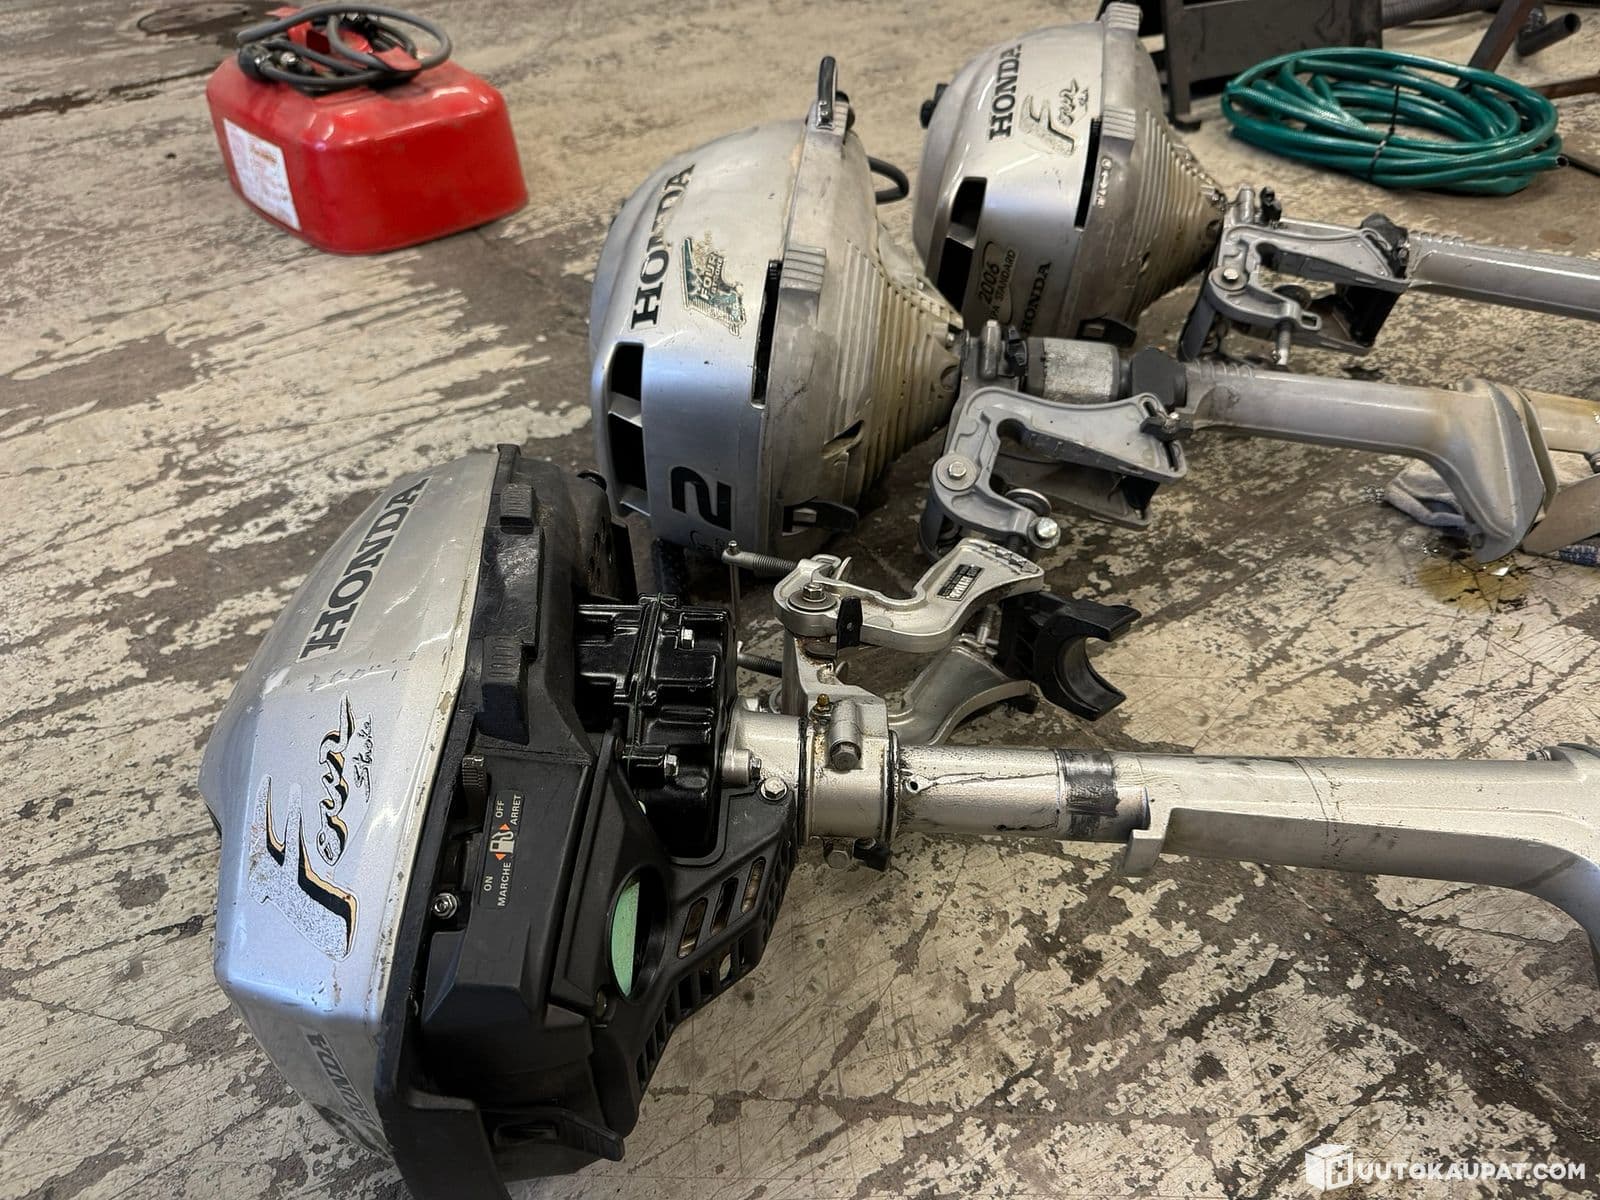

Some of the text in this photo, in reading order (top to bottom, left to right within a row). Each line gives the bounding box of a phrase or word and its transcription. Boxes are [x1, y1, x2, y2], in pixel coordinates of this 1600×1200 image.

[989, 44, 1022, 140] HONDA
[700, 251, 720, 300] FOUR
[978, 262, 1000, 305] 2006
[995, 249, 1016, 302] STANDARD
[1022, 262, 1052, 335] HONDA
[670, 466, 732, 531] 2
[299, 477, 432, 660] HONDA
[495, 800, 505, 818] OFF
[510, 794, 522, 826] ARRET
[483, 875, 494, 892] ON
[497, 862, 512, 907] MARCHE
